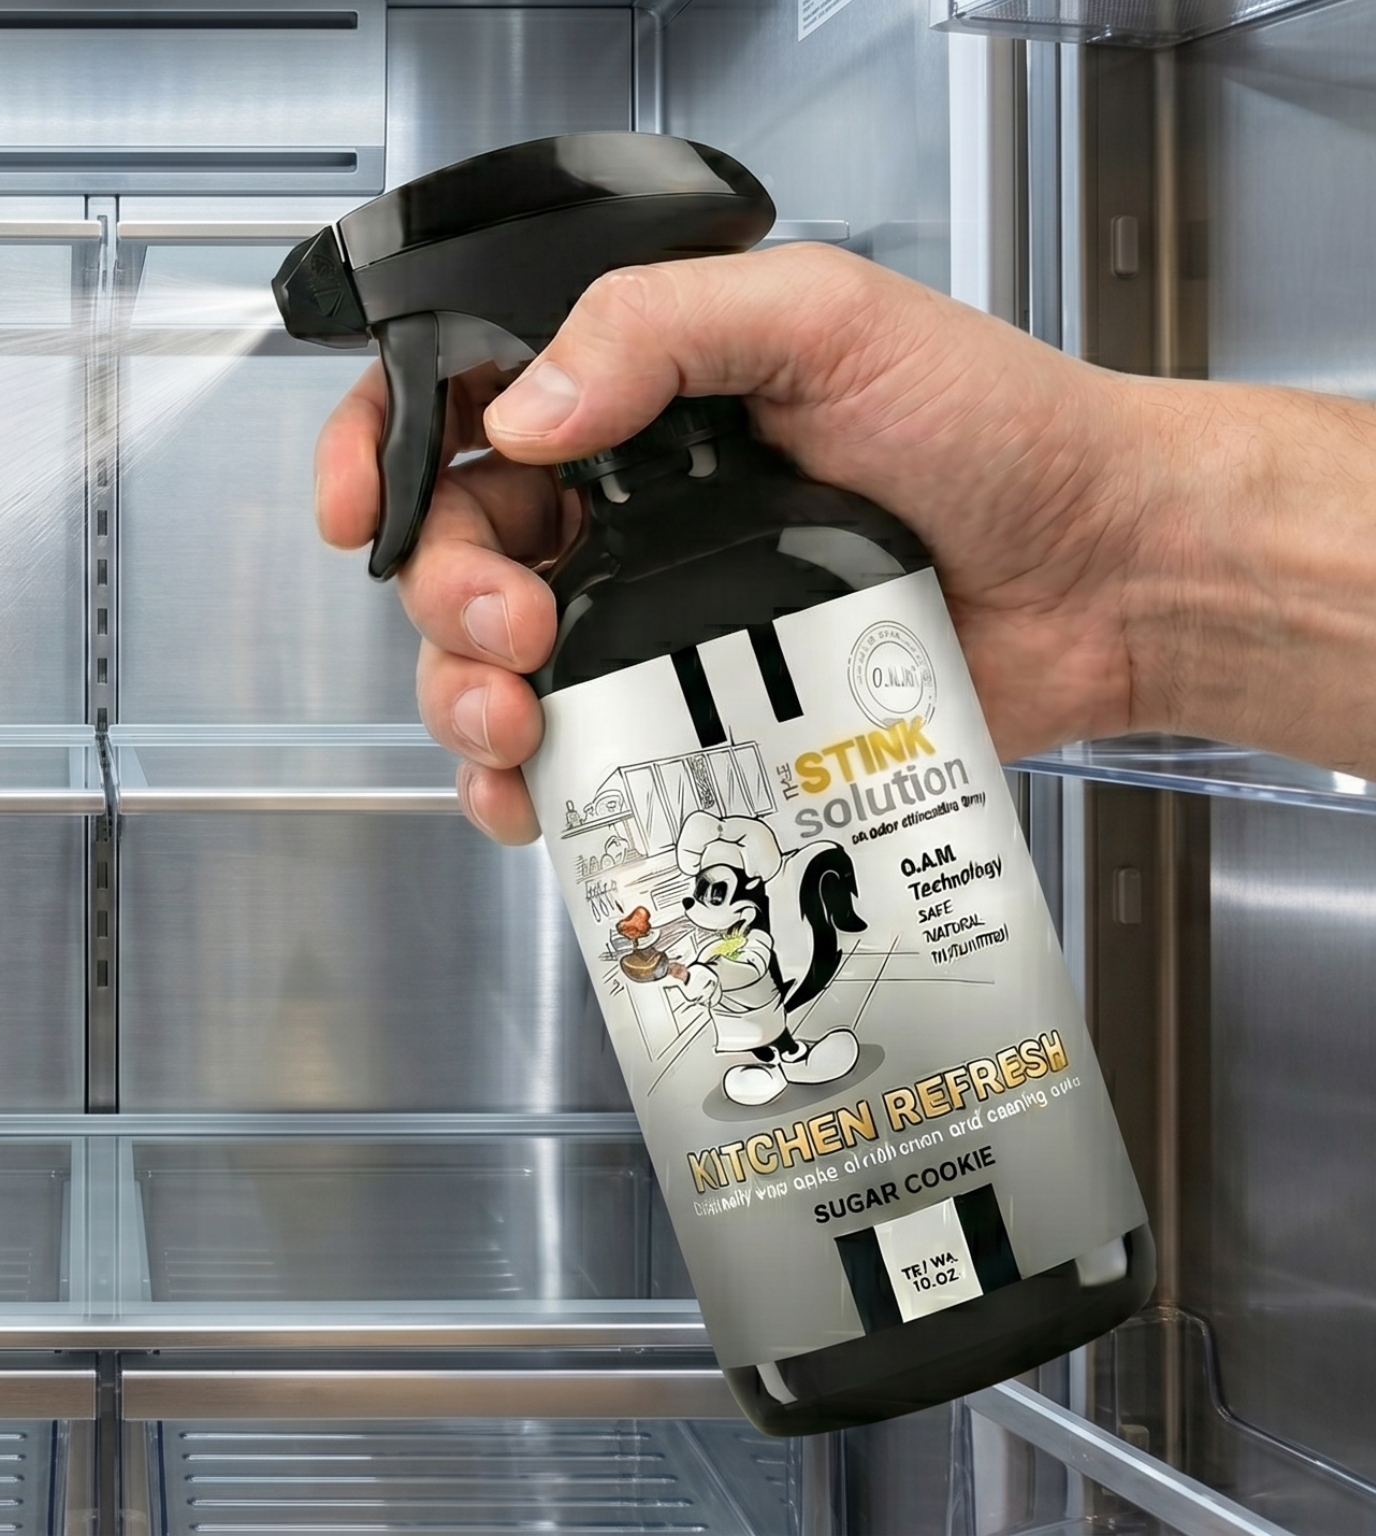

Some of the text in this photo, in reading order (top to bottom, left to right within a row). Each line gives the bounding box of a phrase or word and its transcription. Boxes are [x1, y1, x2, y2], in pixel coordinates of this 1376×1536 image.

[795, 715, 937, 794] STINK
[795, 758, 970, 838] solution
[870, 820, 899, 839] odor
[907, 853, 1003, 901] Technology
[918, 899, 954, 924] SAFE
[687, 1029, 1070, 1194] KITCHEN REFRESH
[814, 1182, 901, 1224] SUGAR
[904, 1145, 997, 1194] COOKIE
